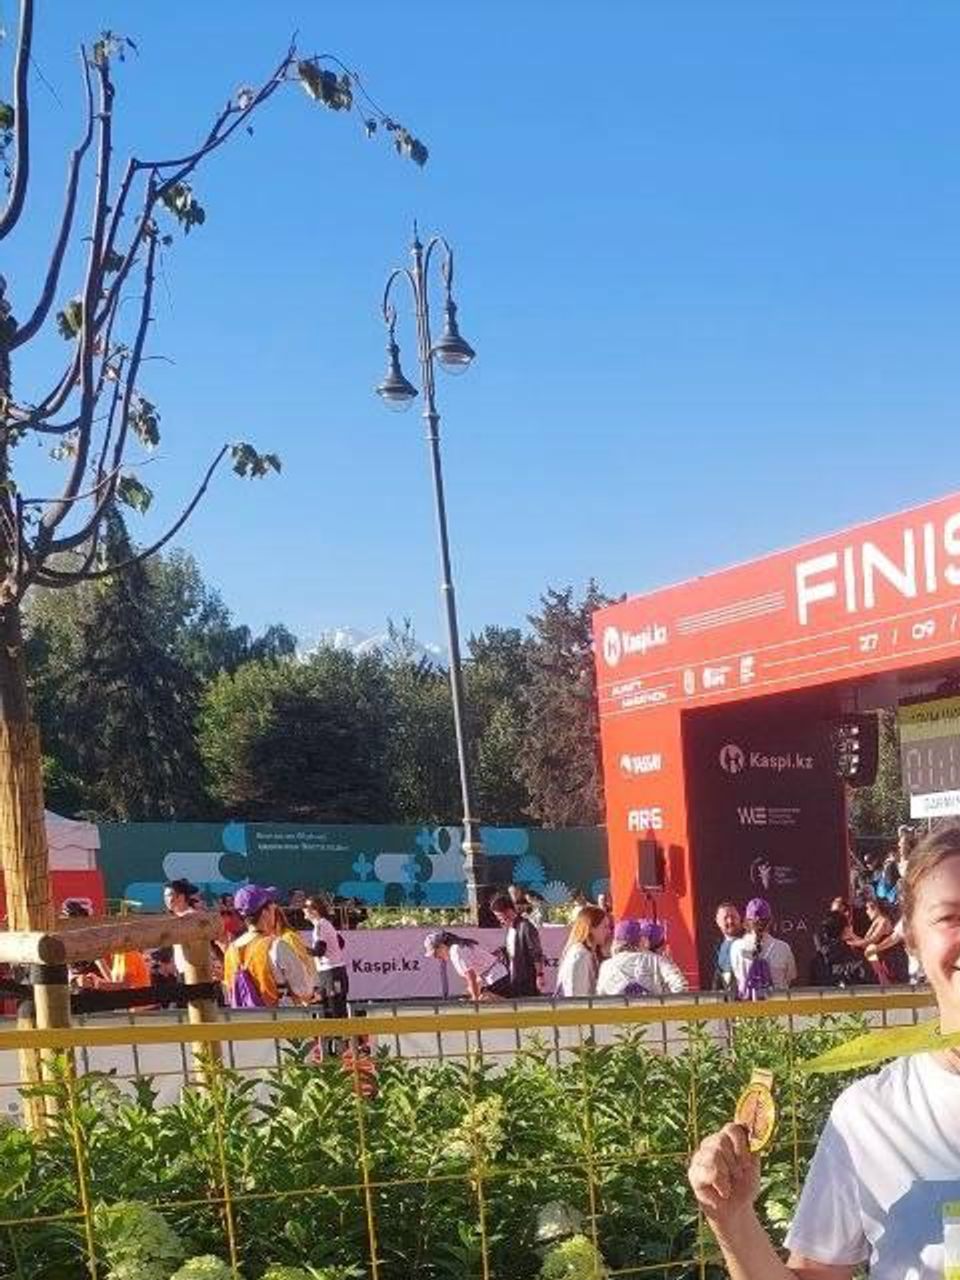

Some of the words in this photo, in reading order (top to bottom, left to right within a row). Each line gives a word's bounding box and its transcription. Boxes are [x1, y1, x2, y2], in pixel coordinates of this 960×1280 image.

[859, 632, 879, 652] 27
[911, 620, 936, 641] 09
[750, 751, 814, 773] Kaspi.kz
[352, 958, 421, 975] Kaspi.kz
